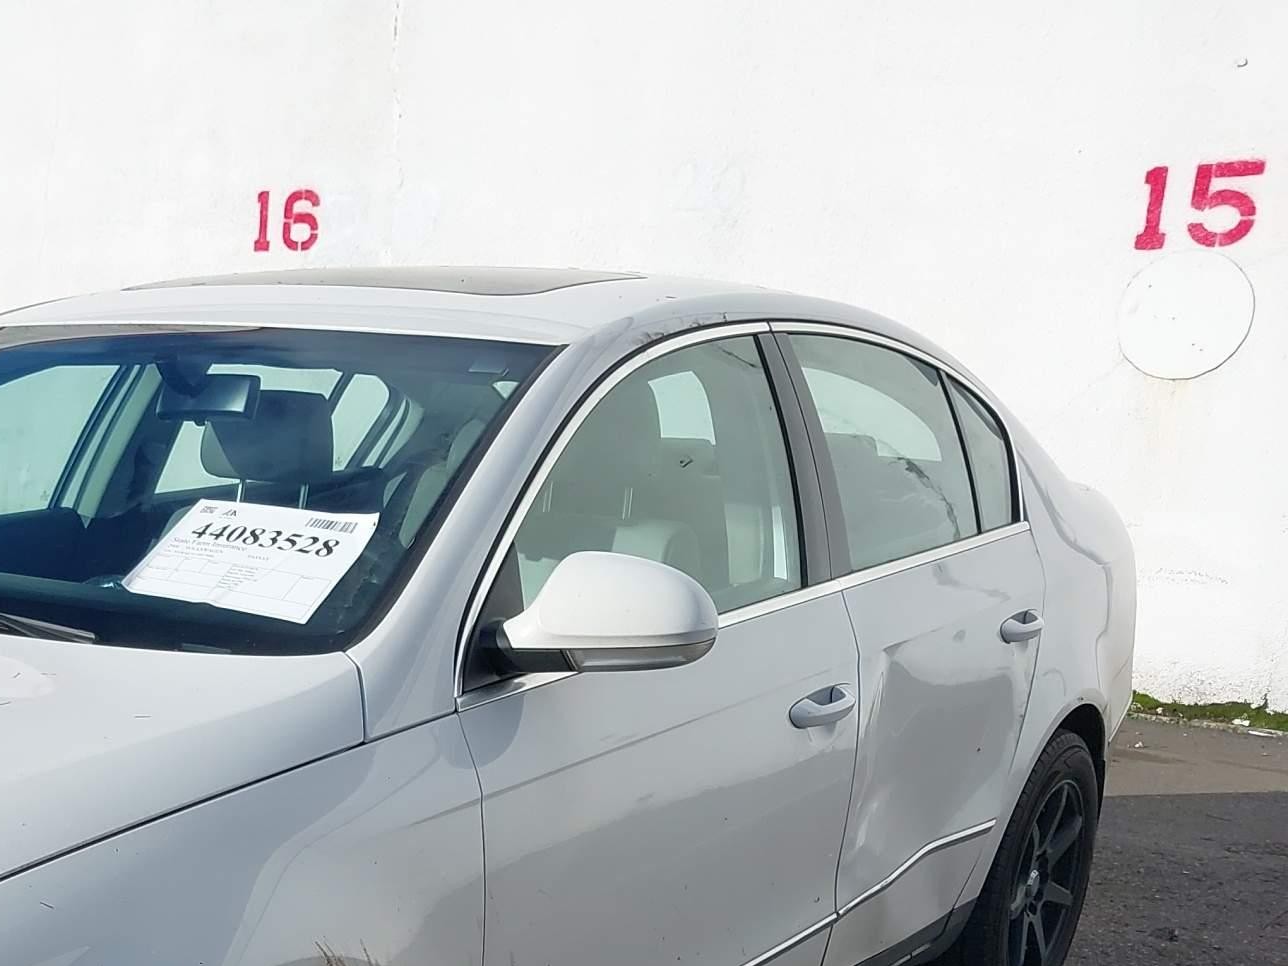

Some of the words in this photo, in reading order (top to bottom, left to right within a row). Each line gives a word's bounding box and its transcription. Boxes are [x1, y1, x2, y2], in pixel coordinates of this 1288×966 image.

[253, 188, 321, 253] 16
[1133, 158, 1267, 252] 15
[191, 521, 341, 558] 44083528
